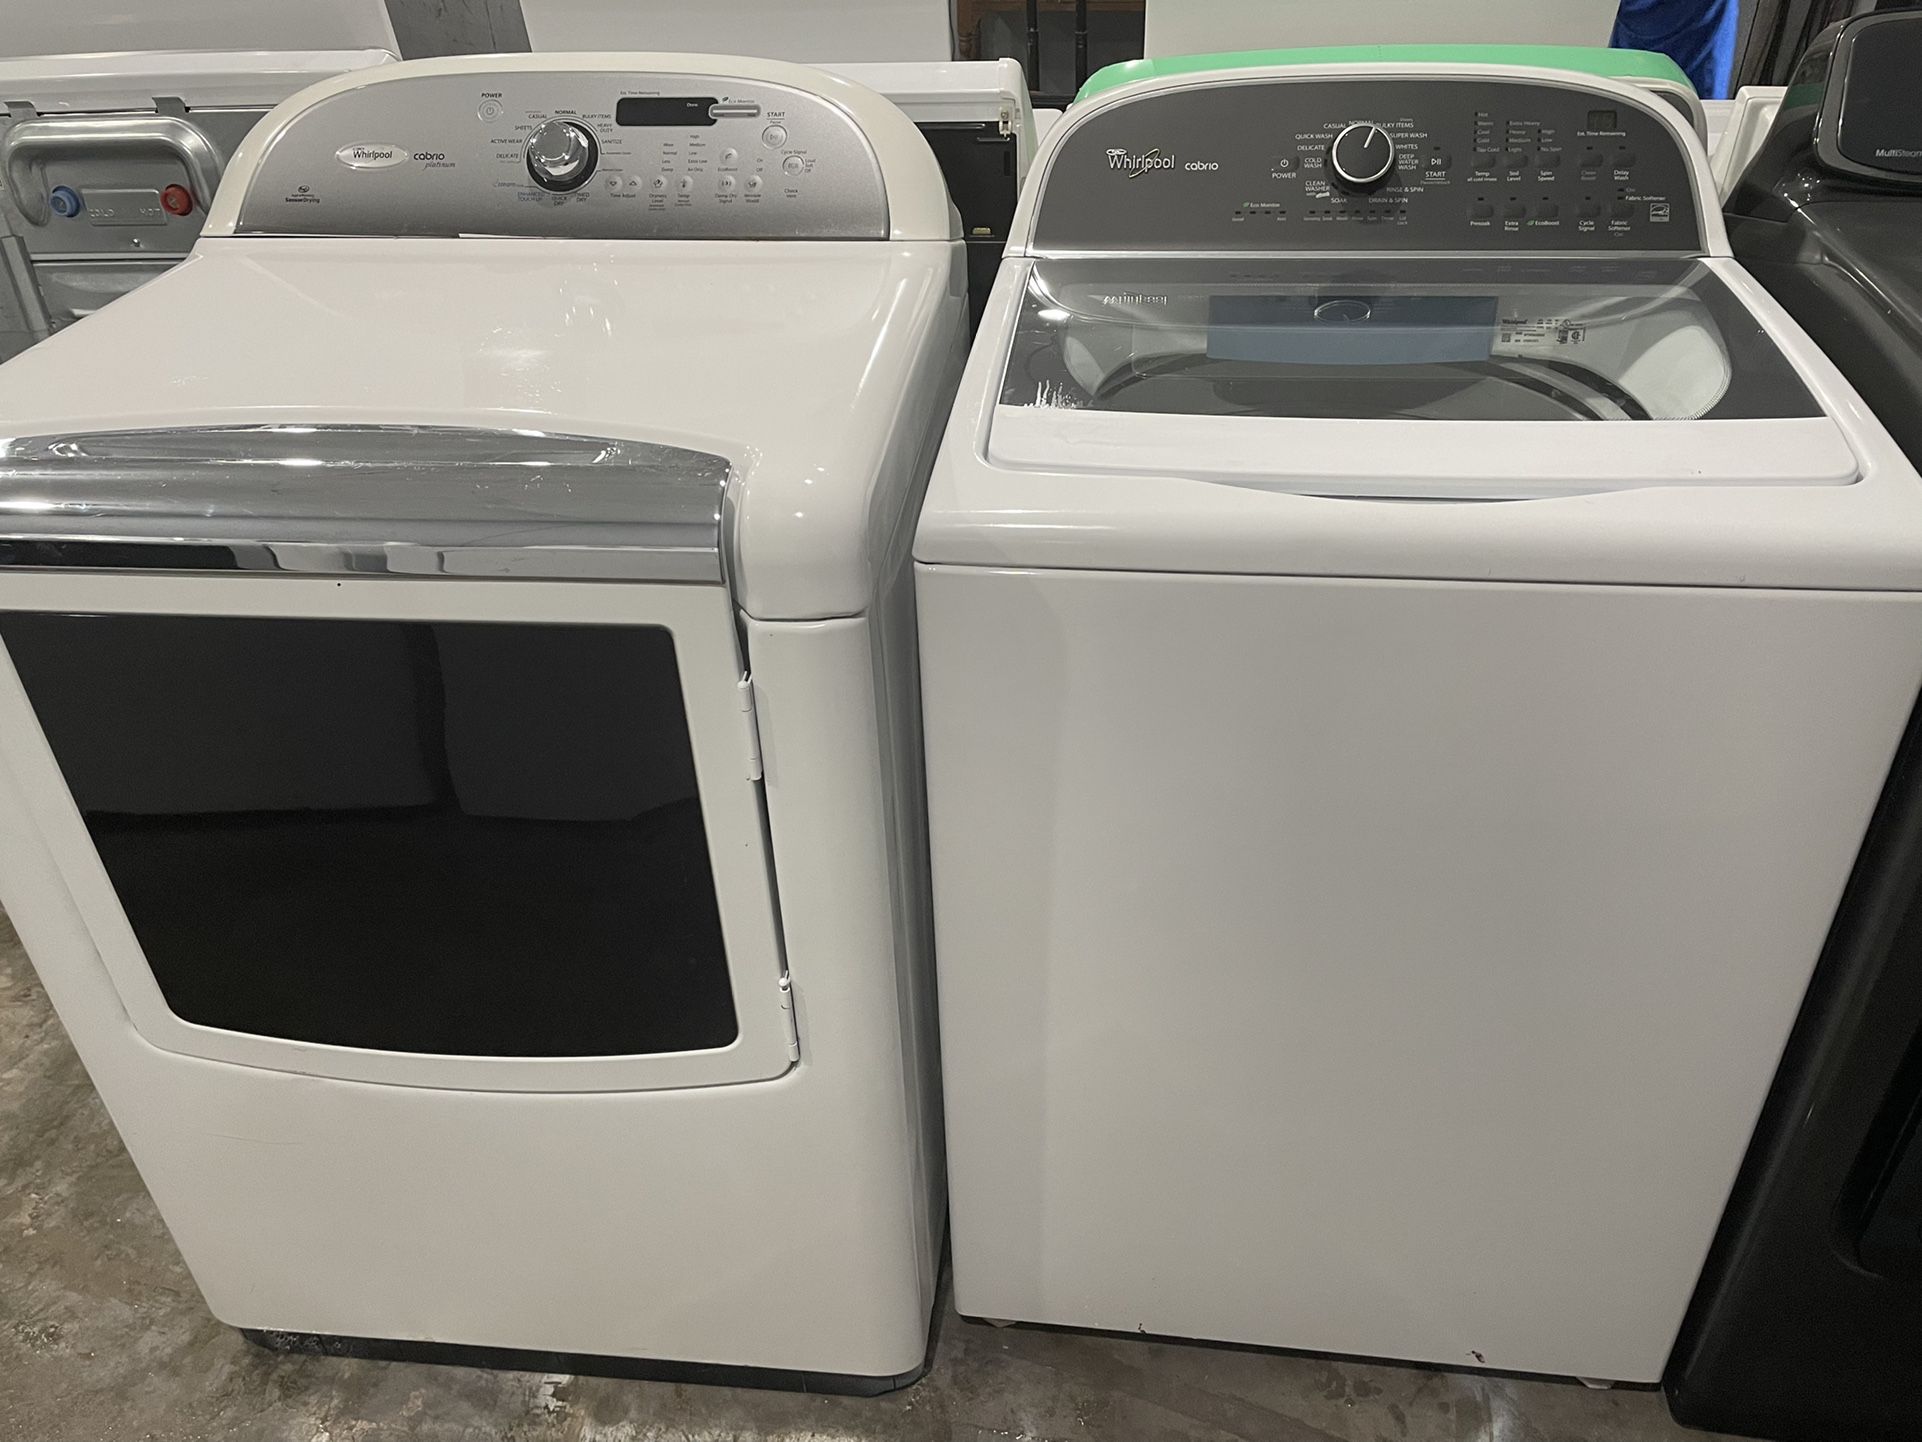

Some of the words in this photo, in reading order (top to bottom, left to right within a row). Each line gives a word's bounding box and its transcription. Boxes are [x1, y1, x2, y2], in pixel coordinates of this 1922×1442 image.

[353, 148, 393, 161] Whirlpool
[414, 152, 445, 160] cabrio
[424, 161, 456, 170] platinum
[1106, 151, 1175, 174] Whirlpool
[1184, 161, 1219, 170] cabrio
